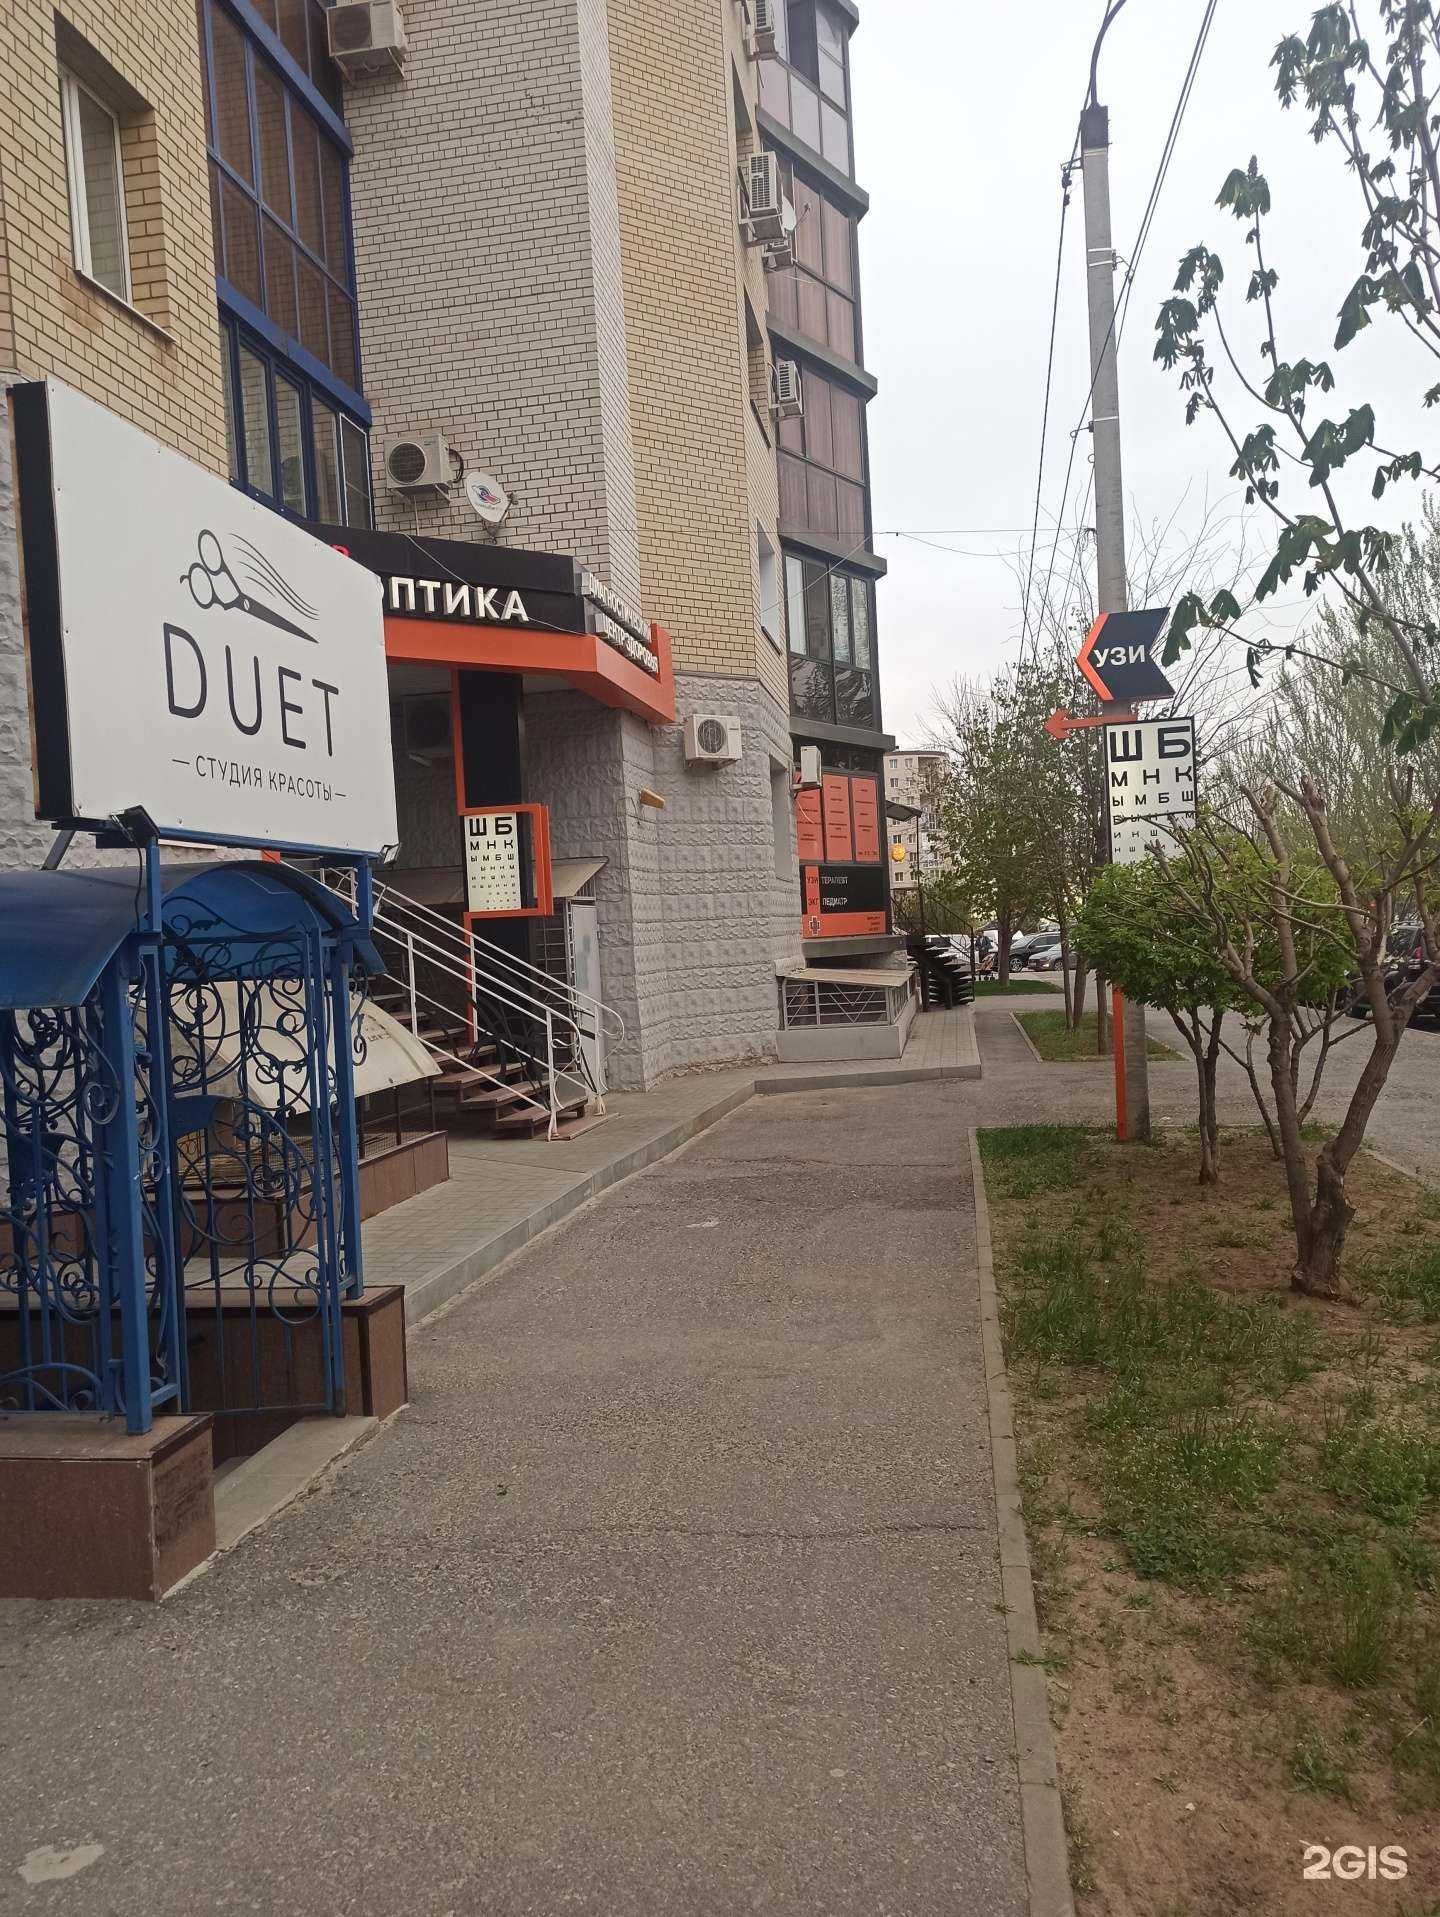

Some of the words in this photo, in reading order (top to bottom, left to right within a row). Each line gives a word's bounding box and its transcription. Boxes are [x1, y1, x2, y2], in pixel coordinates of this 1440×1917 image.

[380, 576, 529, 622] ПТИКА
[1094, 645, 1145, 668] УЗИ
[163, 622, 339, 757] DUET
[195, 755, 263, 788] СТУДИЯ
[269, 771, 332, 801] КРАСОТЫ
